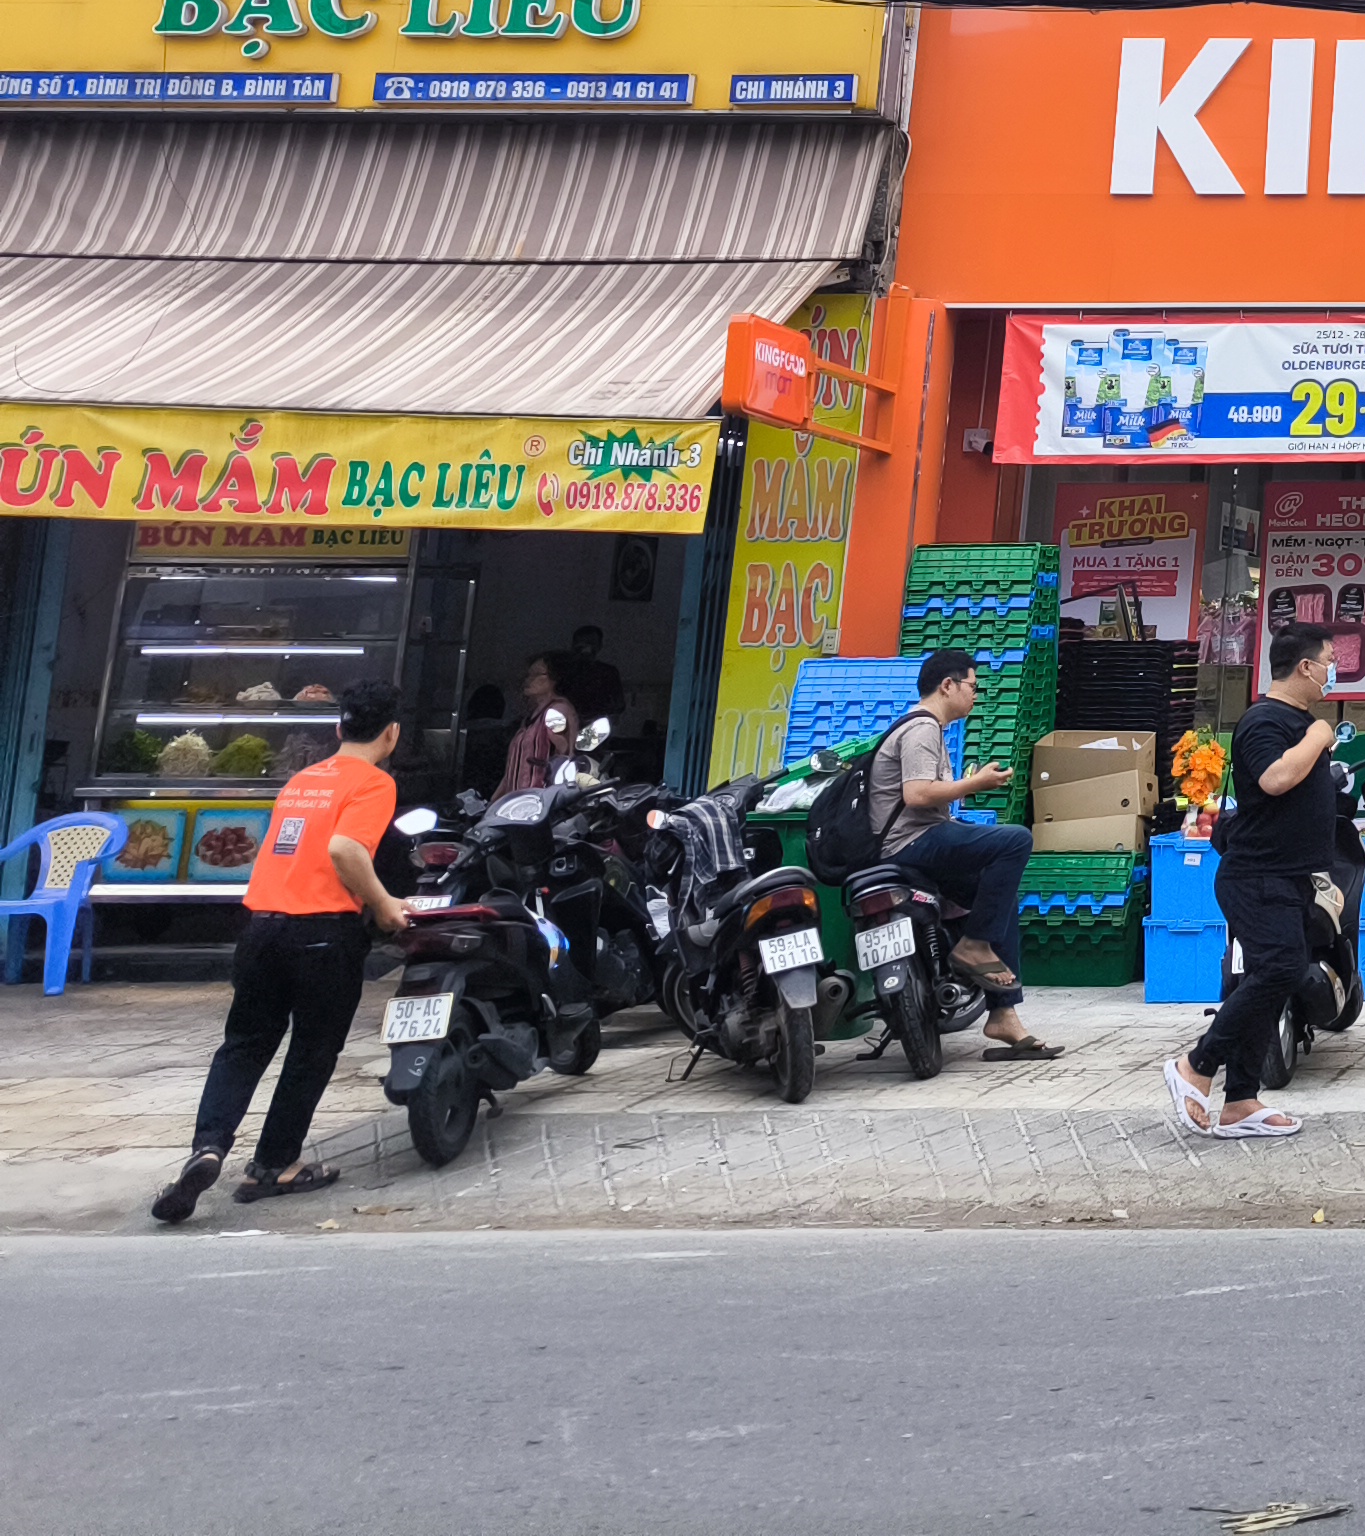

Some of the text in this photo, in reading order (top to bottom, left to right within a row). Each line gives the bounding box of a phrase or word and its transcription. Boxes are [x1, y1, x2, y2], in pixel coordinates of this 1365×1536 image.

[86, 76, 287, 98] BÌNH TRỊ ĐÔNG BÌNH
[428, 80, 679, 99] 0918 878 336 0913 41 61 41
[735, 76, 845, 99] CHI NHÁNH 3
[755, 341, 806, 377] KINGFOOD
[568, 439, 702, 468] Chi Nhánh 3
[132, 418, 338, 516] MẮM
[341, 460, 426, 519] BẠC
[431, 448, 527, 512] LIÊU
[565, 480, 703, 514] 0918.878.336
[1098, 496, 1163, 519] KHAI
[1071, 514, 1187, 542] TRƯƠNG
[1315, 537, 1354, 550] NGỌT
[1072, 552, 1167, 571] MUA TẶNG
[768, 946, 819, 970] 191.16
[861, 938, 912, 968] 107.00
[395, 998, 443, 1020] 50-AC
[386, 1018, 442, 1041] 476.24
